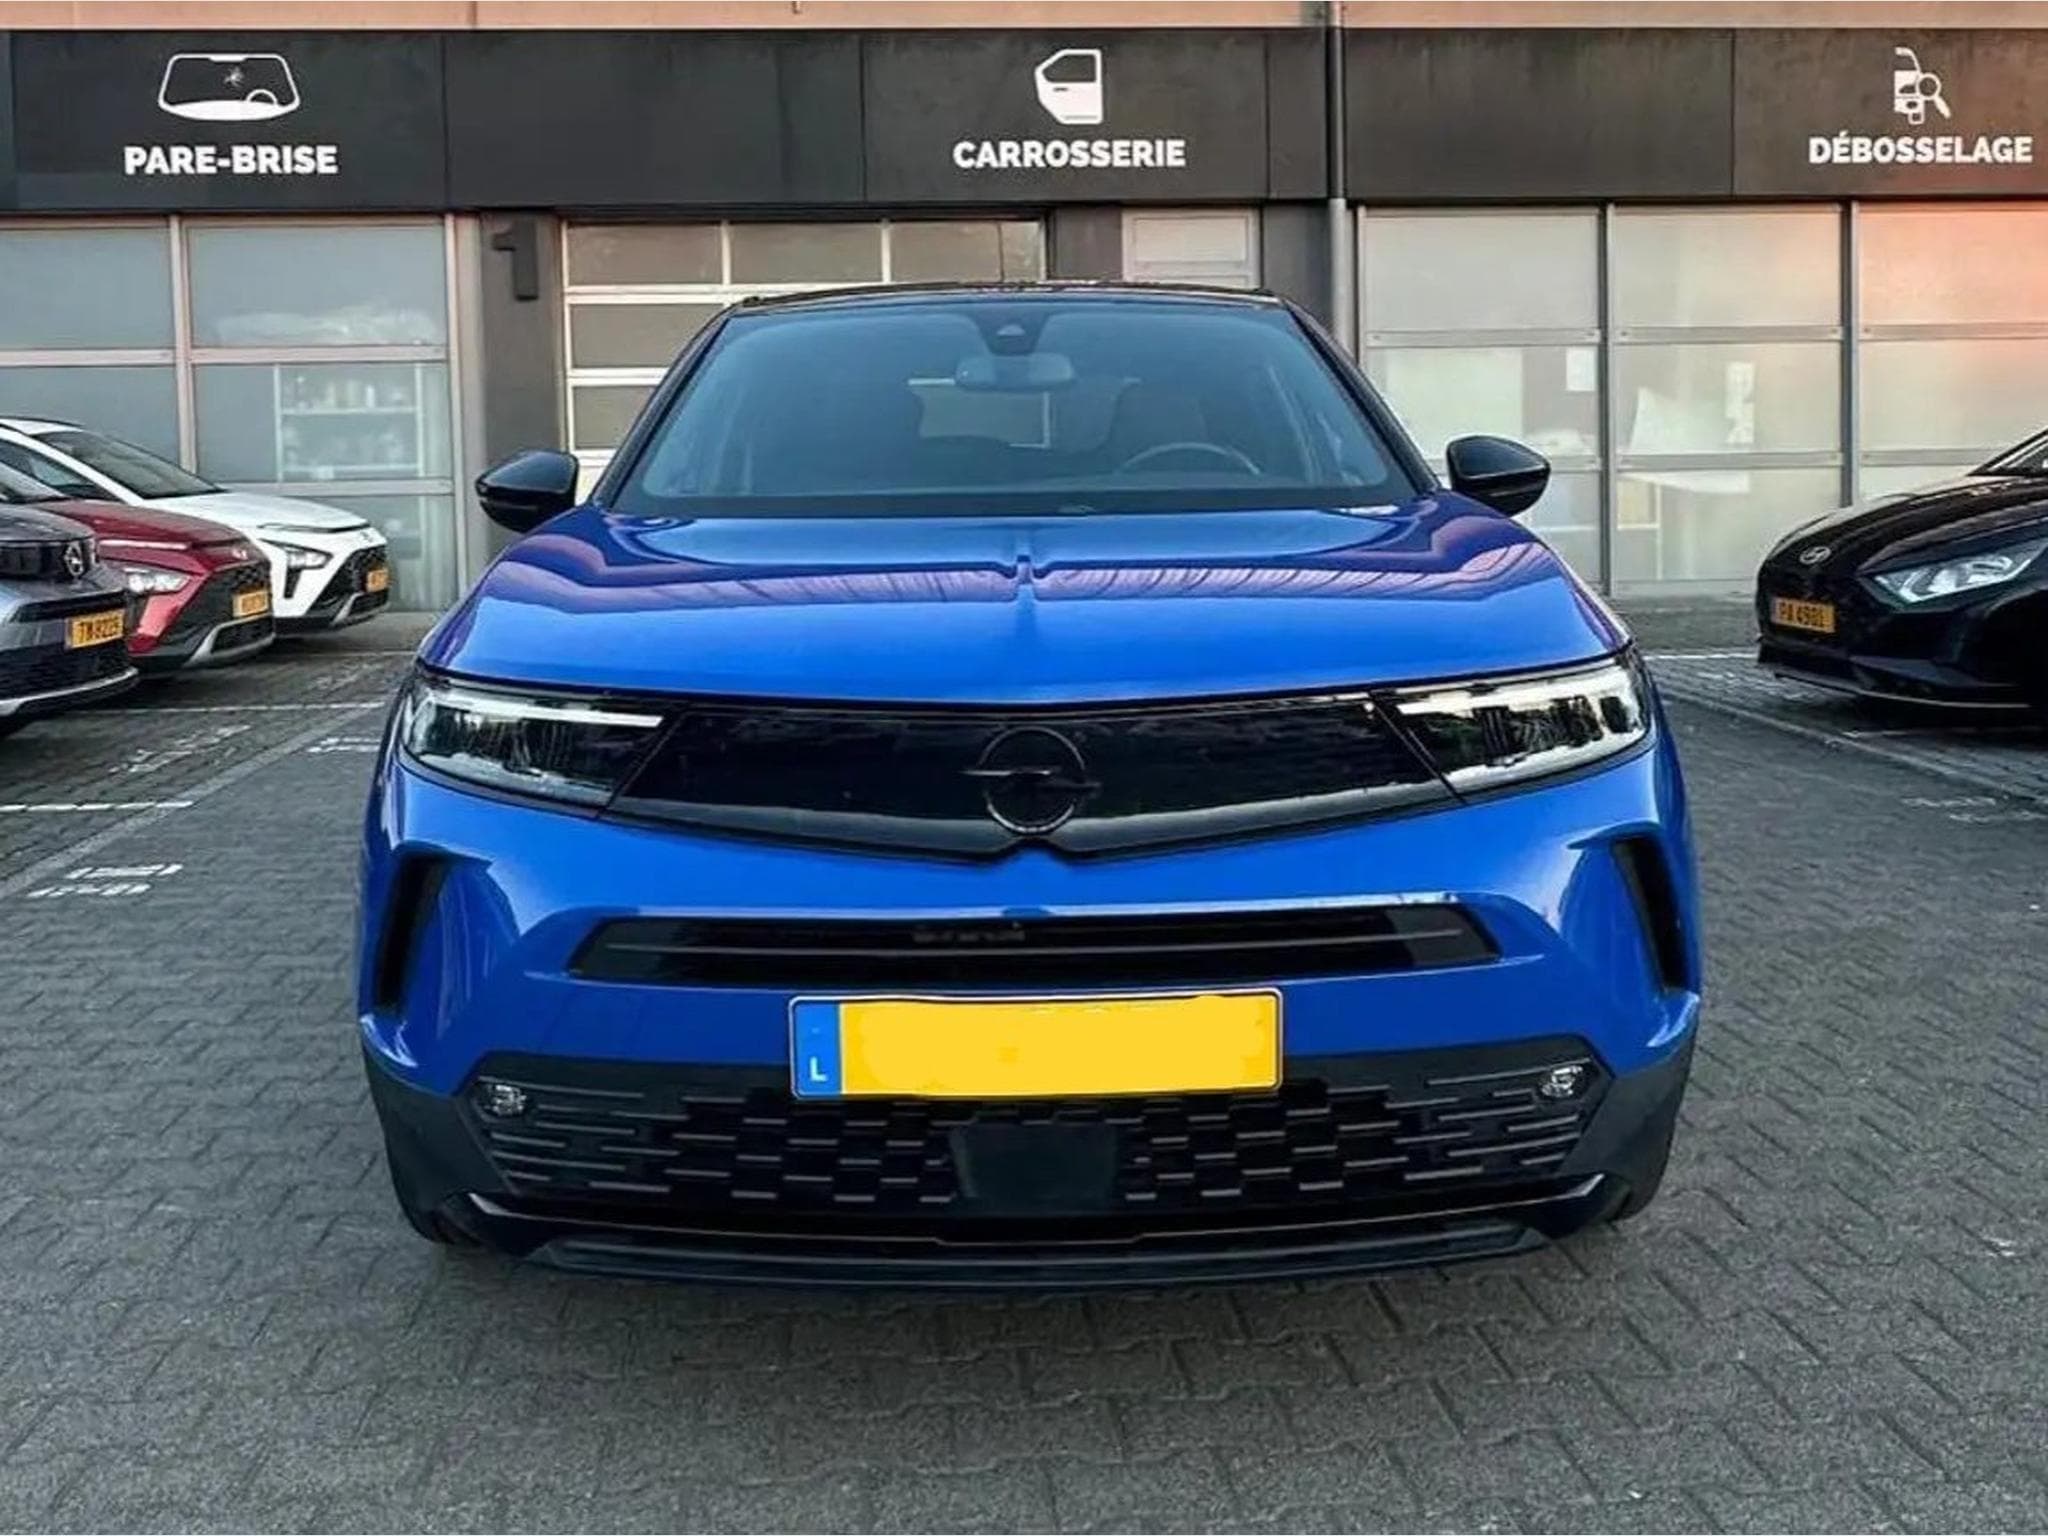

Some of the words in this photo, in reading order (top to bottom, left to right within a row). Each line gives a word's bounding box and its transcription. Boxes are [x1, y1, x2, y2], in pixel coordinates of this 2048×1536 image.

[123, 144, 339, 175] PARE-BRISE
[953, 139, 1186, 169] CARROSSERIE
[1808, 130, 2034, 163] DÉBOSSELAGE
[810, 1056, 828, 1082] L
